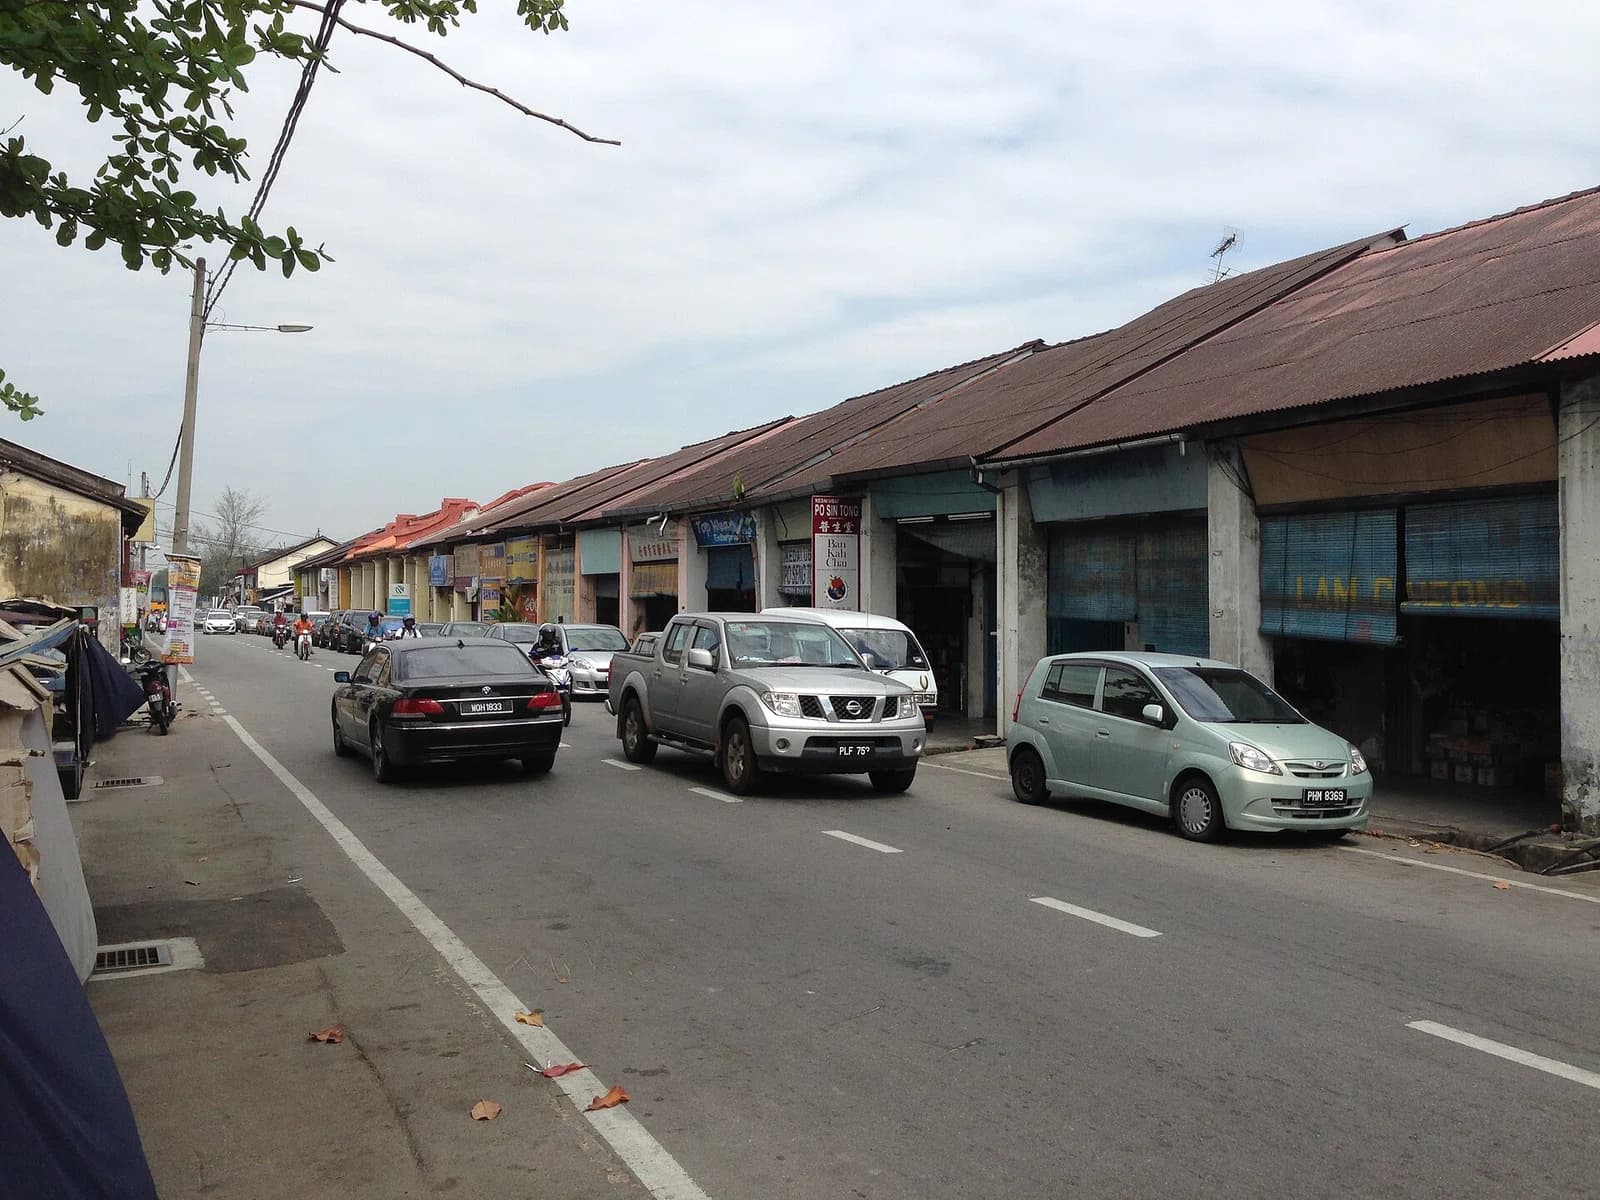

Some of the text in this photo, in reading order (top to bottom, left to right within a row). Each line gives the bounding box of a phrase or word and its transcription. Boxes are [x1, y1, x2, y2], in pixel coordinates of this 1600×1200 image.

[814, 503, 859, 517] PO SIN TONG
[827, 538, 847, 549] Ban
[839, 746, 854, 756] PLF
[1324, 790, 1344, 801] 8369
